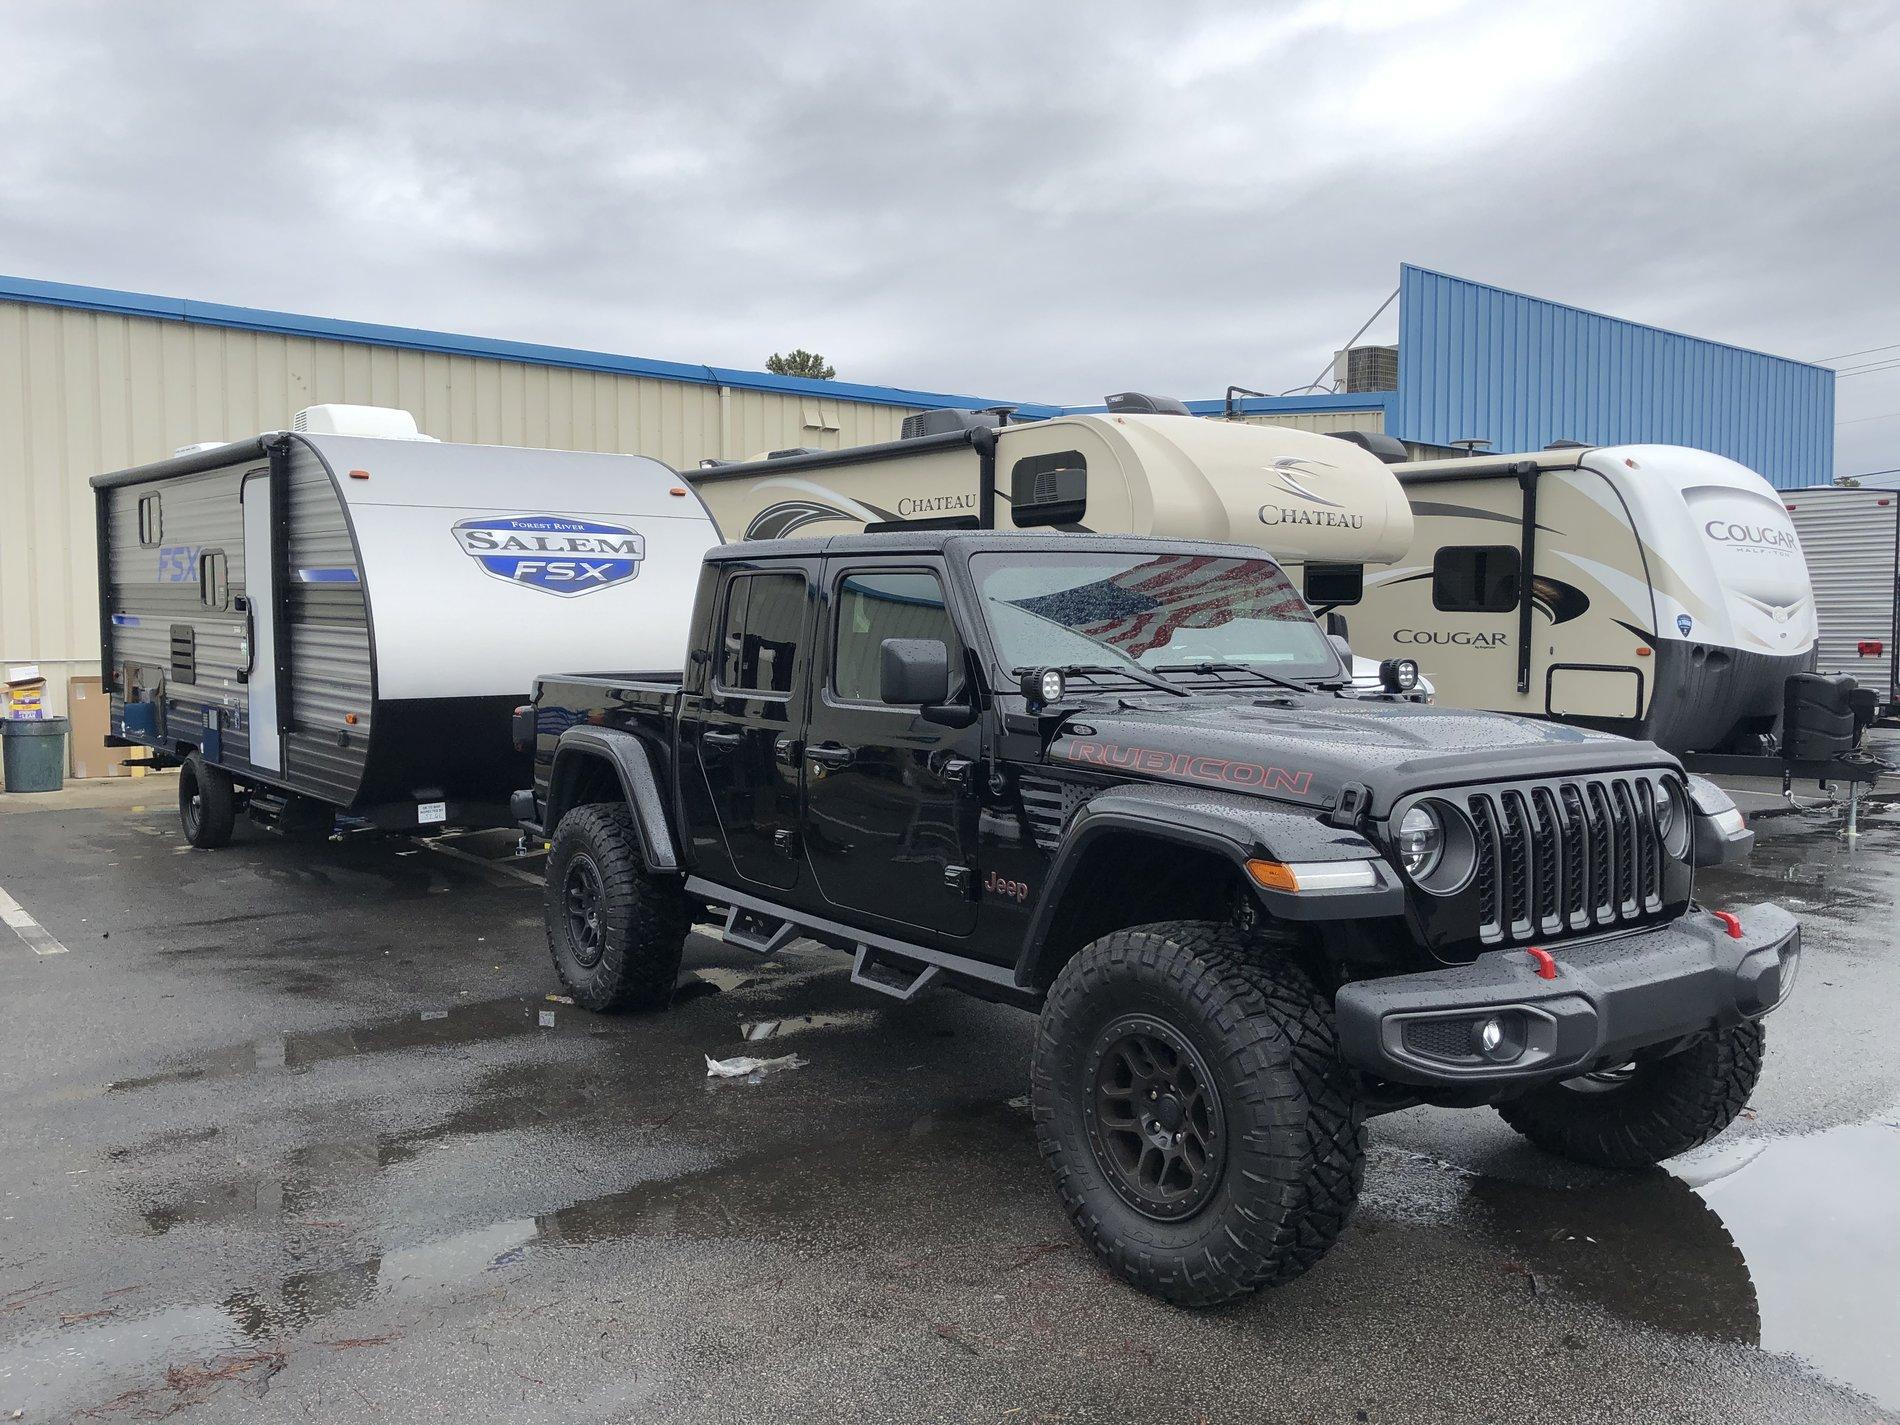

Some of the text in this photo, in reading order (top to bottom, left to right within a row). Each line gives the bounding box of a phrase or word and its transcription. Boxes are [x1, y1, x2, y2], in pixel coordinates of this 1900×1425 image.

[897, 494, 977, 516] CHATEAU
[1257, 504, 1364, 530] CHATEAU
[510, 520, 585, 532] FOREST RIVER
[1705, 520, 1798, 551] COUGAR
[465, 531, 641, 555] SALEM
[158, 546, 203, 582] FSX
[513, 561, 614, 581] FSX
[1392, 629, 1510, 646] COUGAR
[1068, 740, 1313, 795] RUBICON
[984, 871, 1028, 903] Jeep
